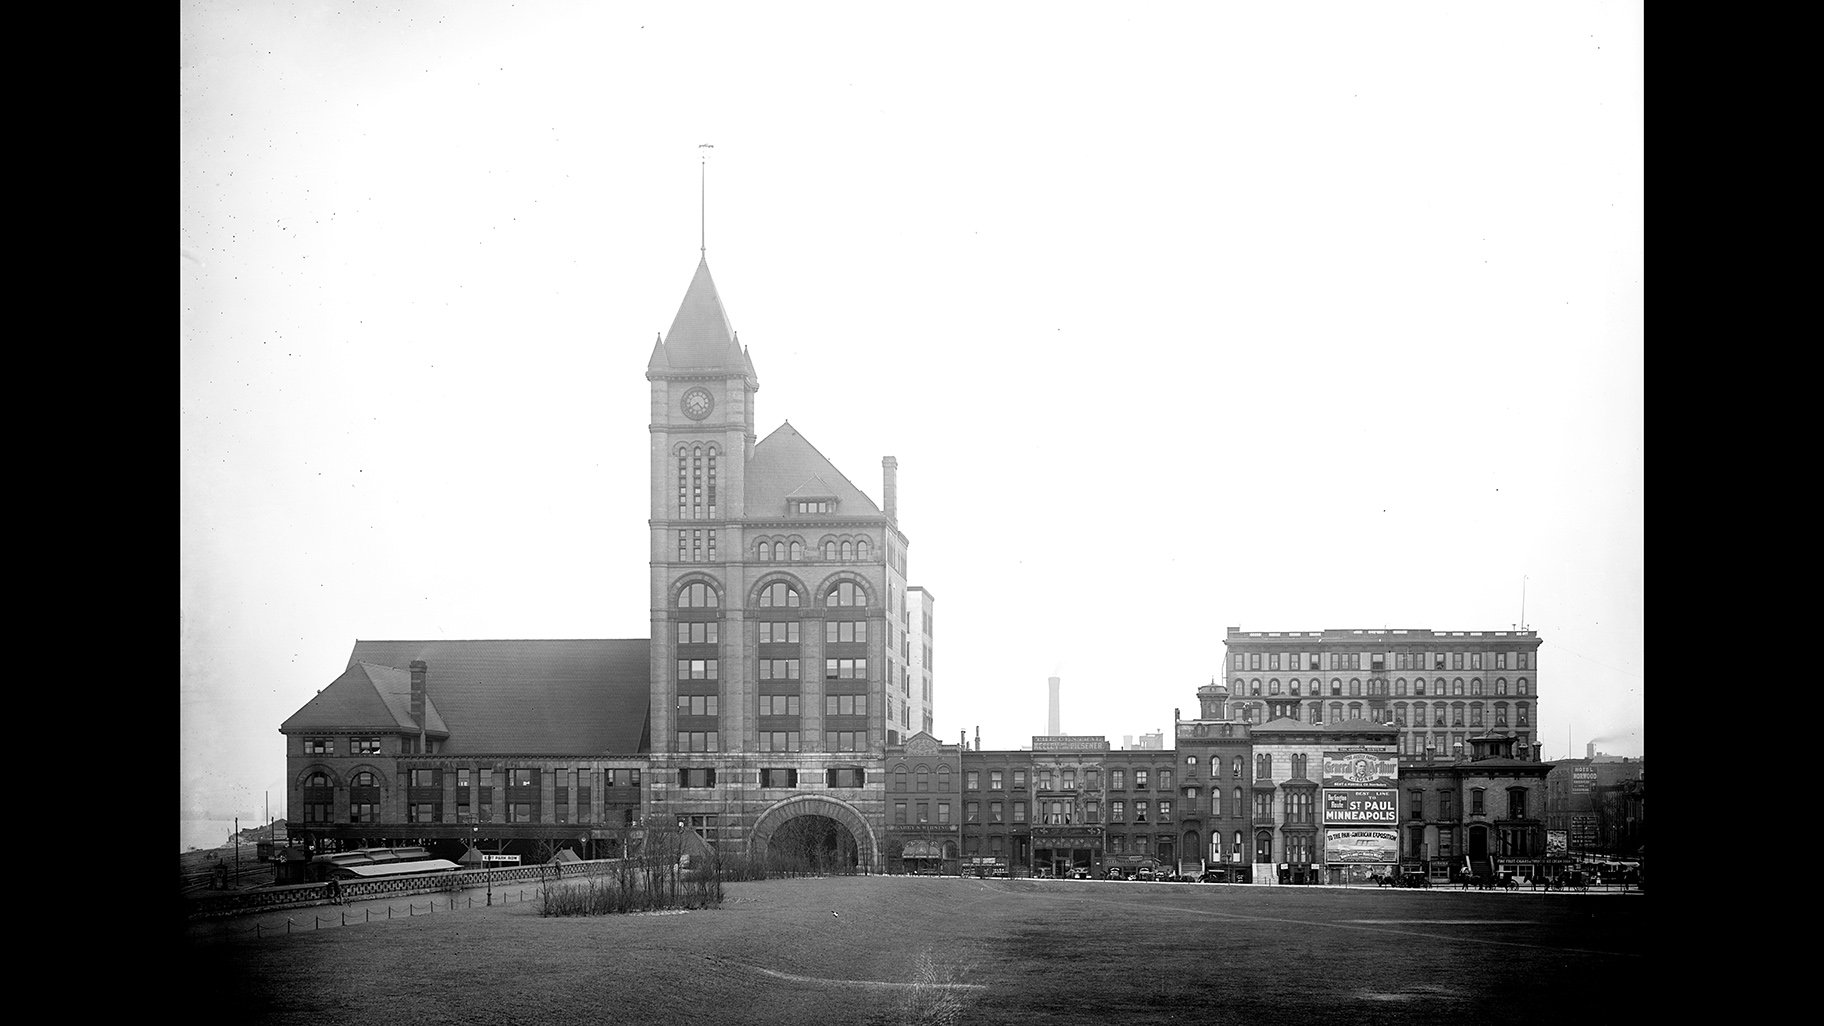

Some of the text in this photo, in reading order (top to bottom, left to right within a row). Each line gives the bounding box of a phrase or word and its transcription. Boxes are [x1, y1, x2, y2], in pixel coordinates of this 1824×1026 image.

[1070, 742, 1103, 750] PILSENER
[1365, 760, 1397, 775] Arthur
[1364, 801, 1395, 810] PAUL
[1326, 811, 1395, 820] MINNEAPOLIS
[1372, 832, 1397, 842] EXPOSITION
